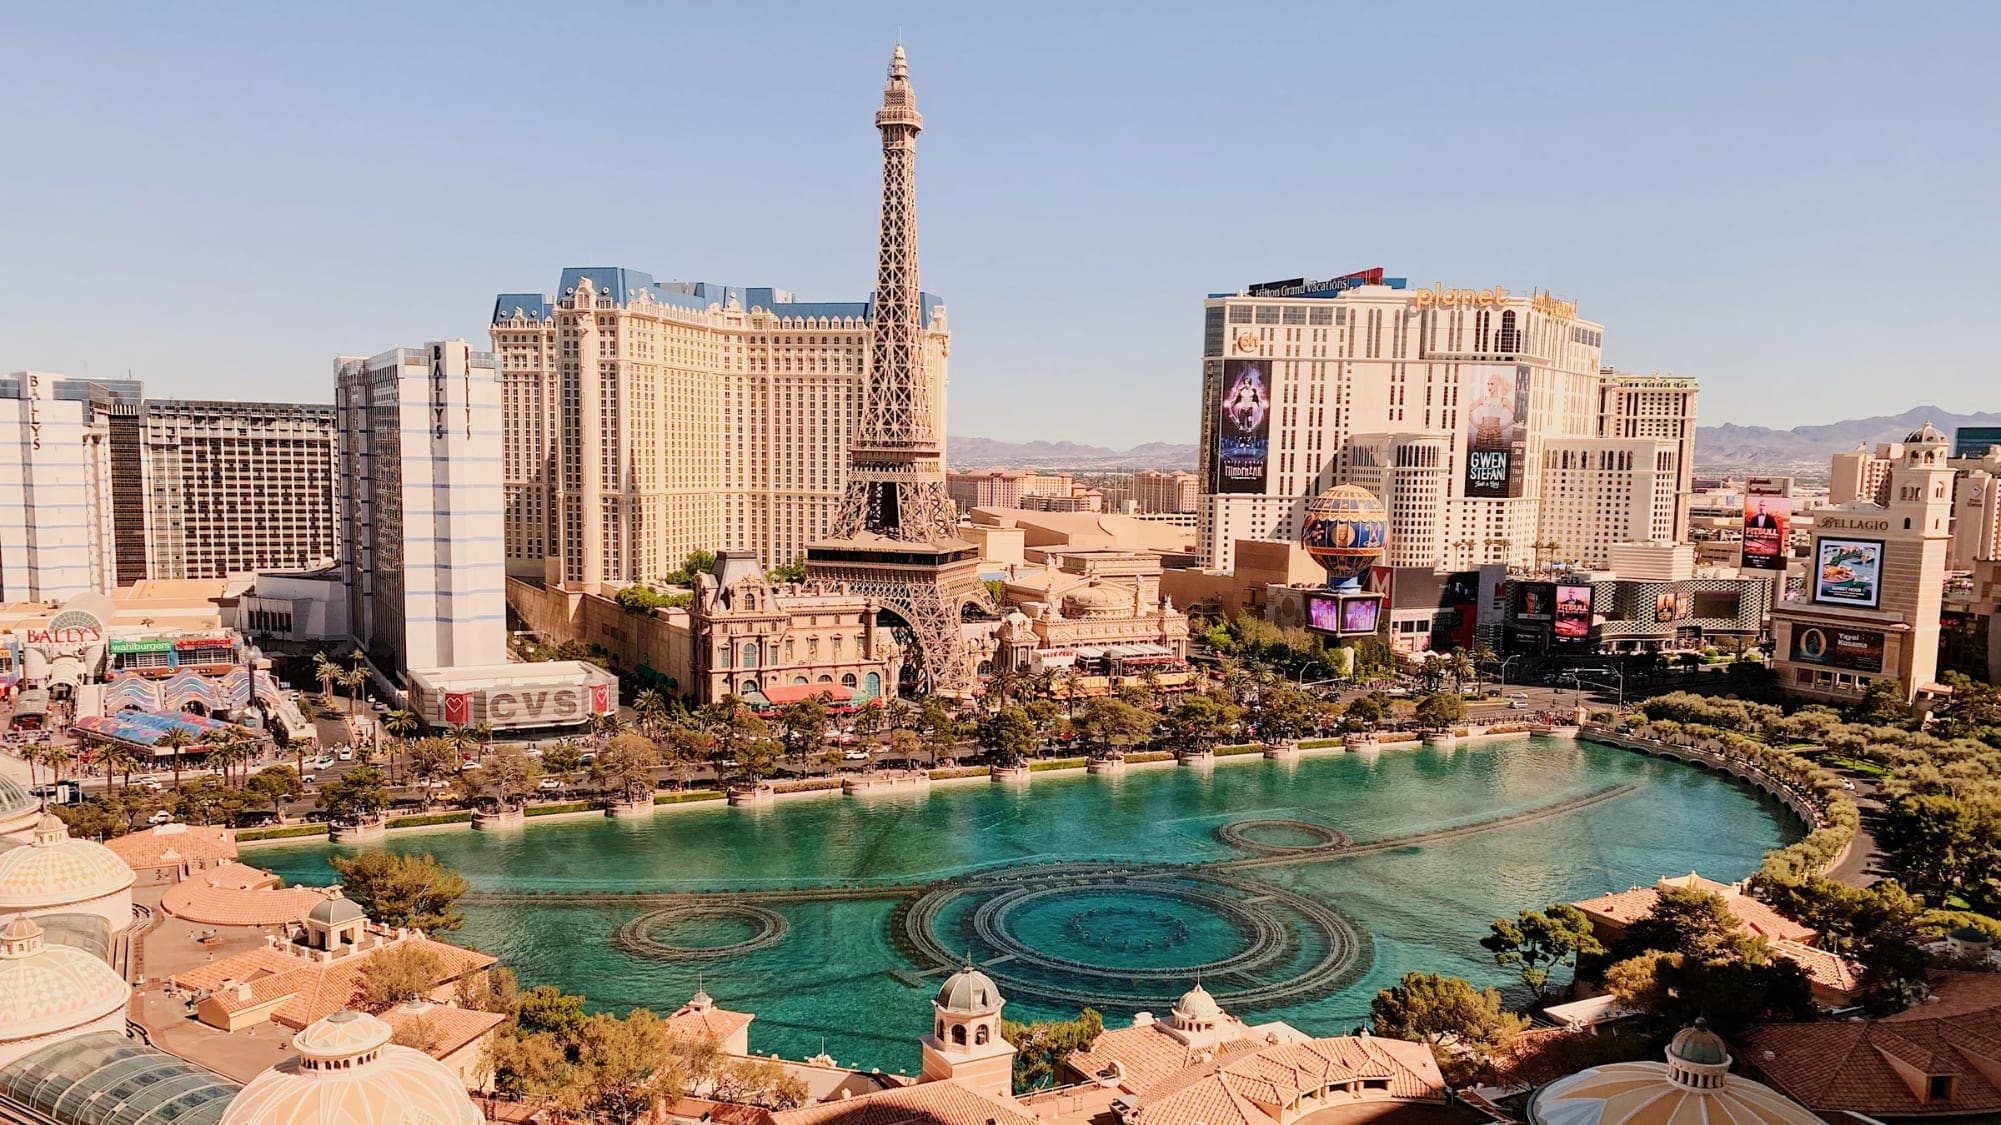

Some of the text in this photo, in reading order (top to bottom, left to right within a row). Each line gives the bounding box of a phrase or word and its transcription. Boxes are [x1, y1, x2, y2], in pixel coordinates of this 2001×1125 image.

[1255, 278, 1347, 297] Hilton Grand Vacations
[1416, 281, 1510, 311] planet
[1470, 451, 1507, 468] GWEN
[1470, 467, 1506, 481] STEFANI
[1817, 516, 1889, 531] BELLAGIO
[27, 627, 101, 644] BALLY'S
[112, 641, 171, 653] wahlburgers
[489, 689, 578, 721] CVS
